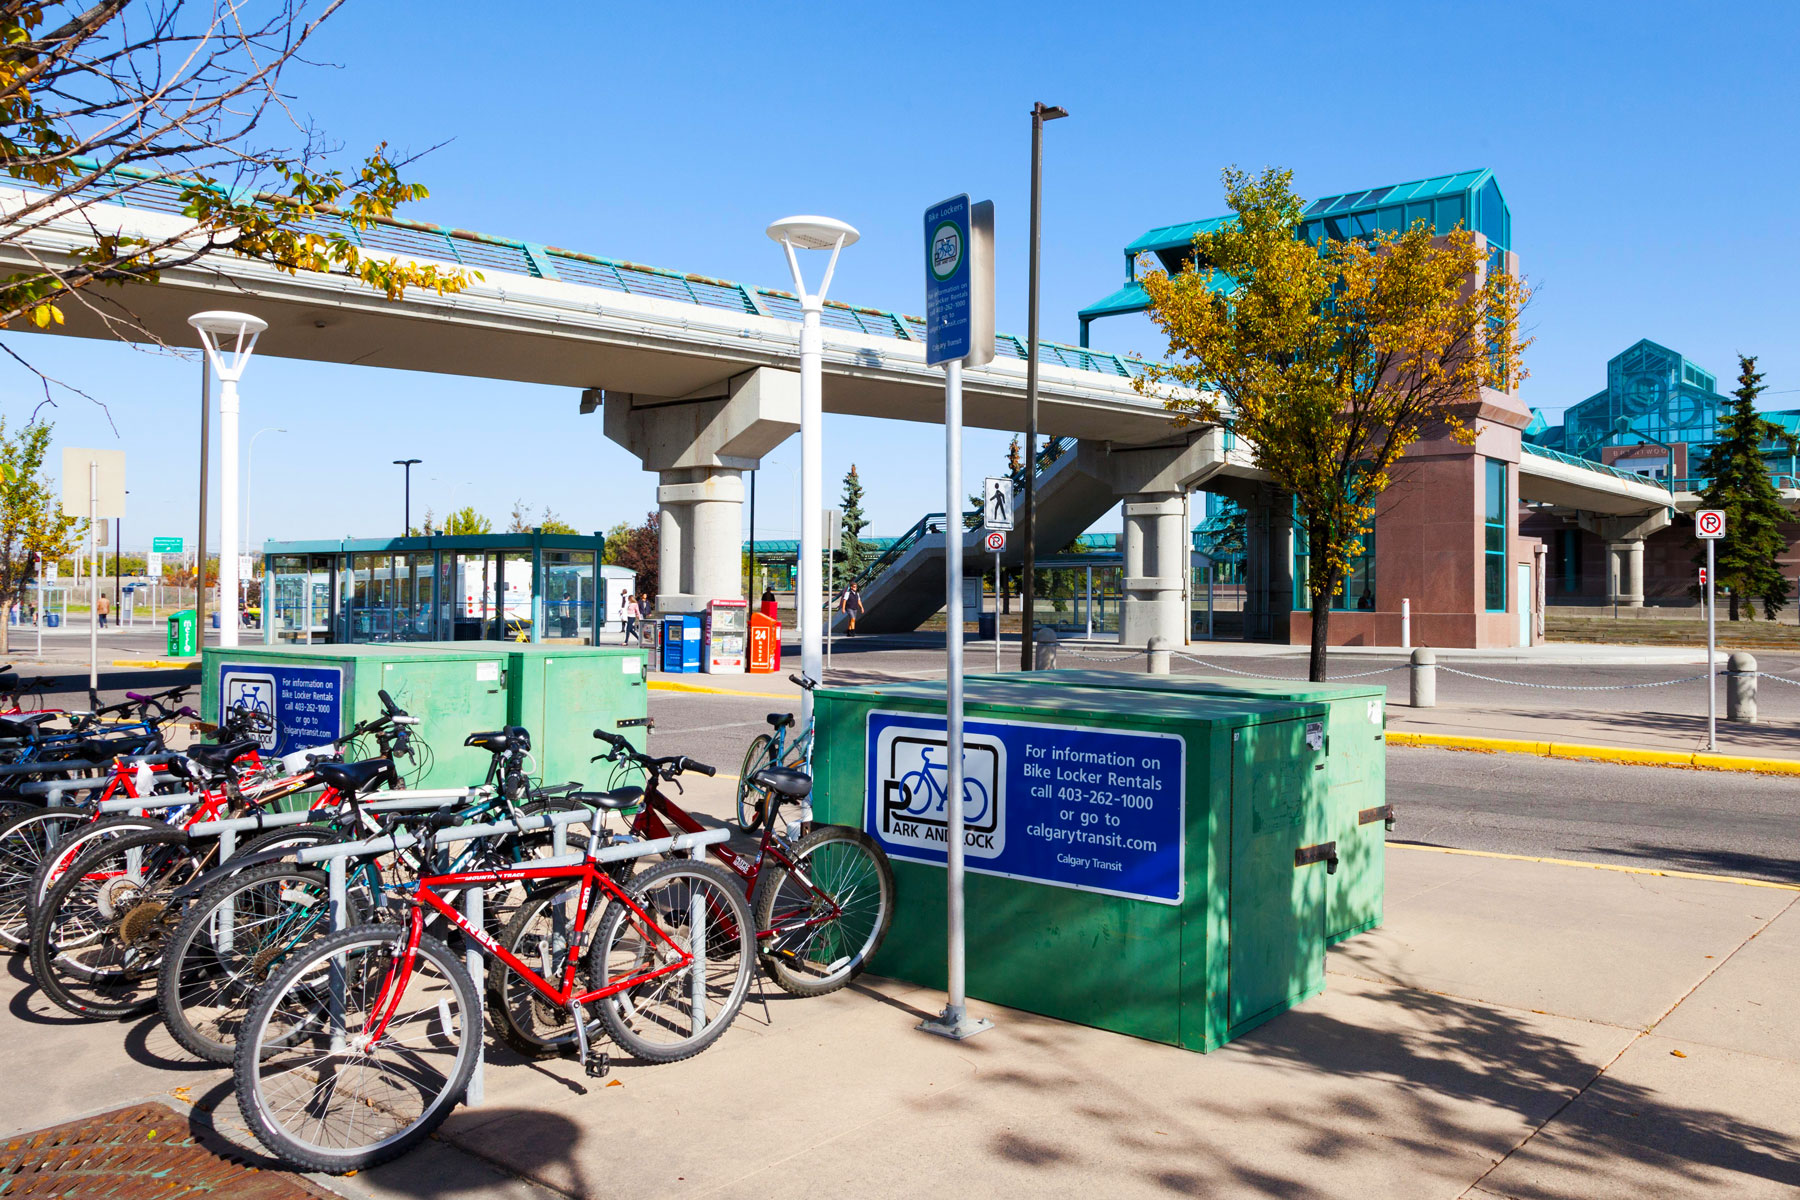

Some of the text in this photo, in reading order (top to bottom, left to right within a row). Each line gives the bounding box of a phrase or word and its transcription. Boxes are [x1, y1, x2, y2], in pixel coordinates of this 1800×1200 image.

[928, 203, 964, 222] Bike Lockers
[755, 630, 766, 640] 24
[282, 678, 291, 686] For
[293, 678, 323, 689] information
[282, 690, 334, 701] Bike Locker Rentals
[285, 702, 330, 713] call 403-262-1000
[303, 717, 310, 725] go
[1026, 744, 1161, 770] For information on
[1024, 764, 1162, 790] Bike Locker Rentals
[1030, 784, 1154, 810] call 403-262-1000
[1060, 809, 1120, 827] or go to
[964, 832, 994, 850] OCK
[1026, 823, 1157, 852] calgarytransit.com
[1057, 853, 1122, 872] Calgary Transit
[582, 887, 590, 910] 830
[455, 911, 500, 952] TREK
